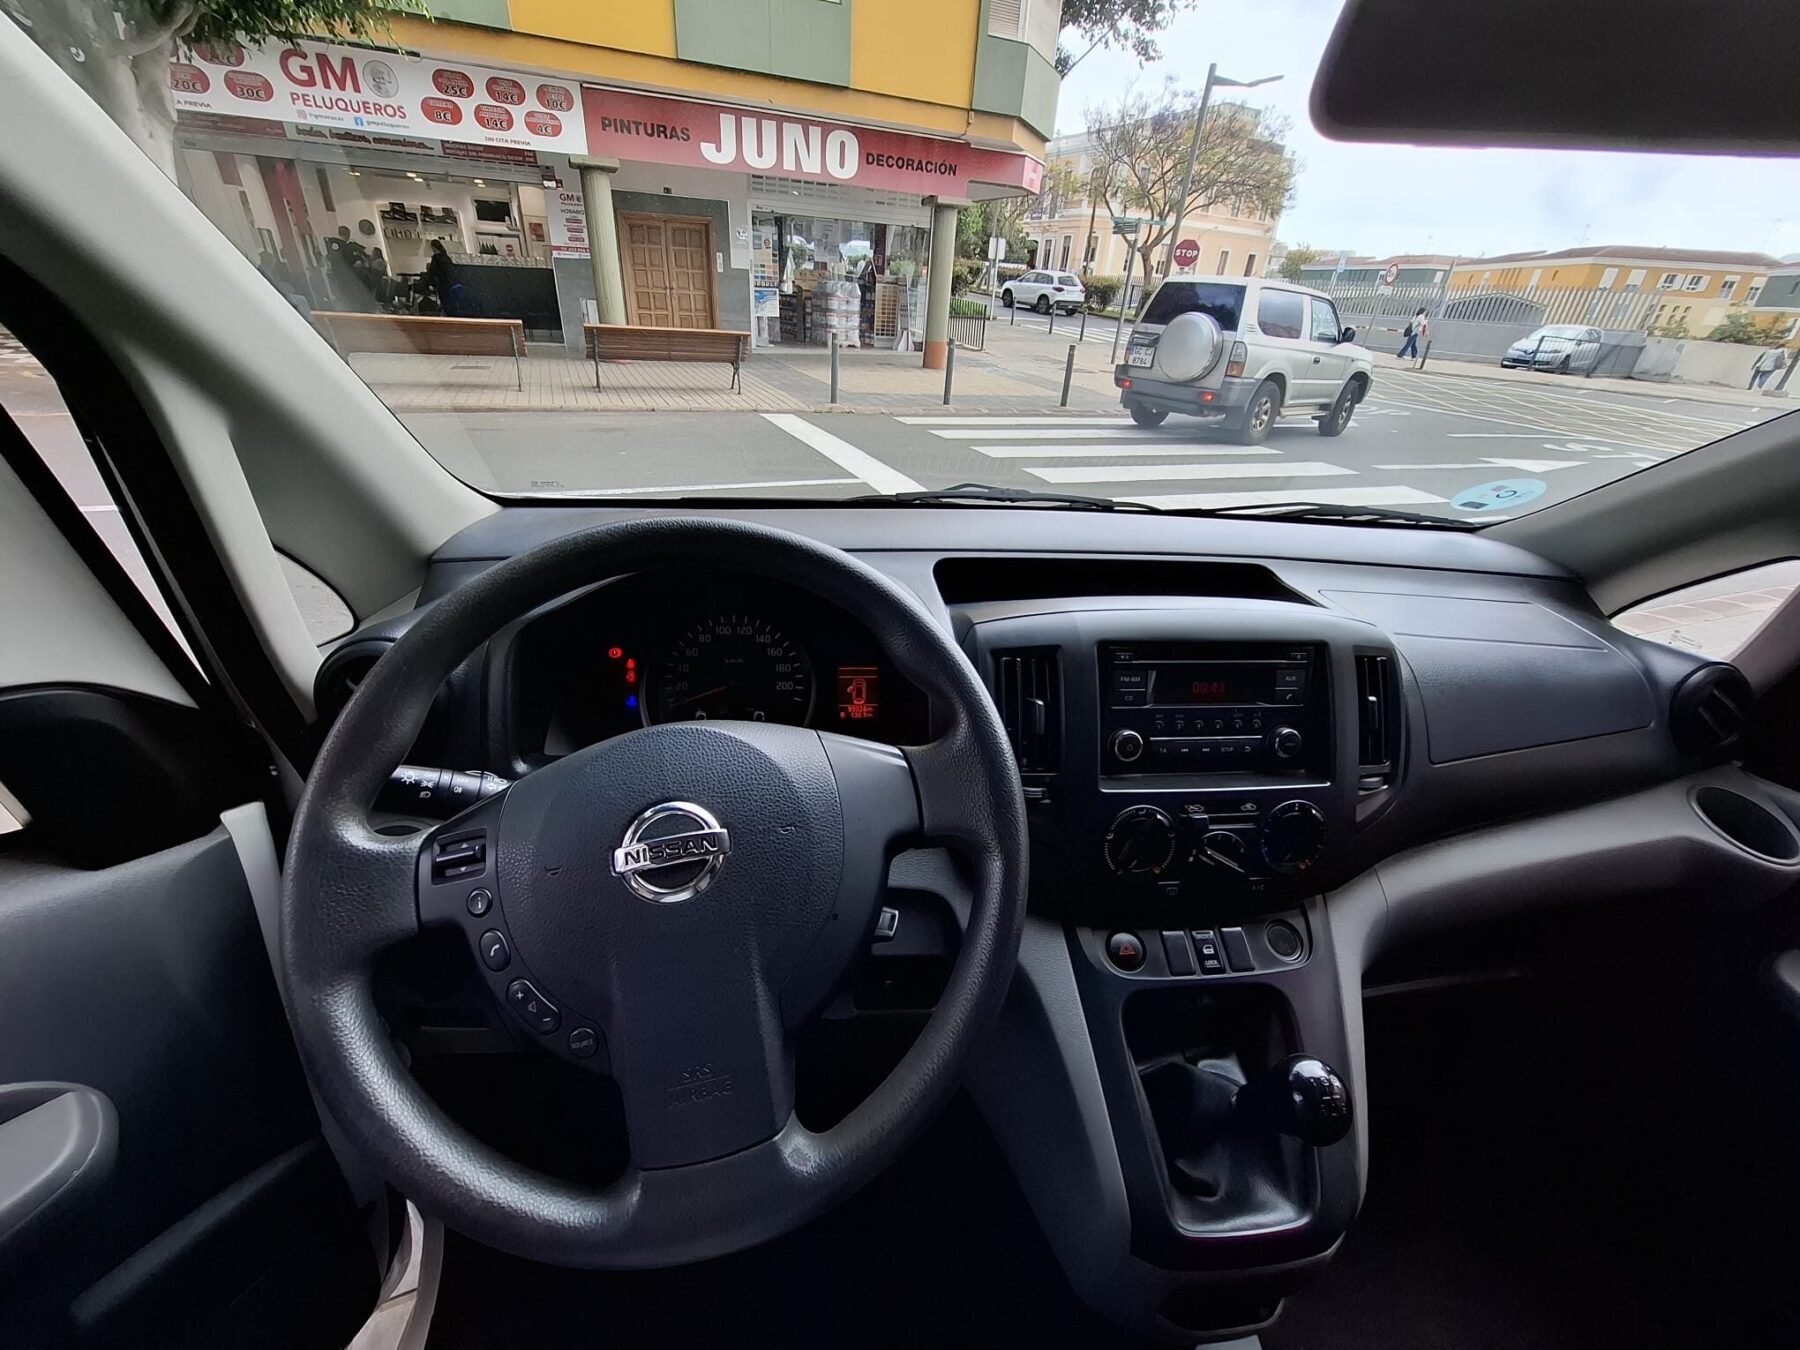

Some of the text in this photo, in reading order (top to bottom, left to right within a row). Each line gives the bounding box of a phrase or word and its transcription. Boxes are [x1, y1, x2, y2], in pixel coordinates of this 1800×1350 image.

[280, 48, 361, 94] GM
[170, 79, 202, 92] 20€
[442, 84, 468, 97] 25€
[238, 86, 265, 100] 30€
[495, 90, 518, 103] 14€
[290, 91, 407, 119] PELUQUEROS
[545, 98, 567, 111] 10€
[434, 109, 452, 122] 8€
[484, 118, 507, 130] 14€
[536, 124, 553, 136] 4€
[600, 116, 691, 143] PINTURAS
[510, 139, 532, 147] PREVIA
[700, 113, 860, 180] JUNO
[865, 151, 958, 177] DECORACIÓN
[559, 193, 576, 203] GM
[1175, 248, 1199, 258] STOP
[715, 625, 732, 636] 100
[737, 625, 753, 636] 120
[698, 633, 712, 644] 80
[755, 633, 772, 645] 140
[685, 647, 699, 657] 60
[767, 647, 783, 657] 160
[775, 663, 792, 673] 180
[775, 681, 794, 691] 200
[624, 834, 719, 867] NISSAN
